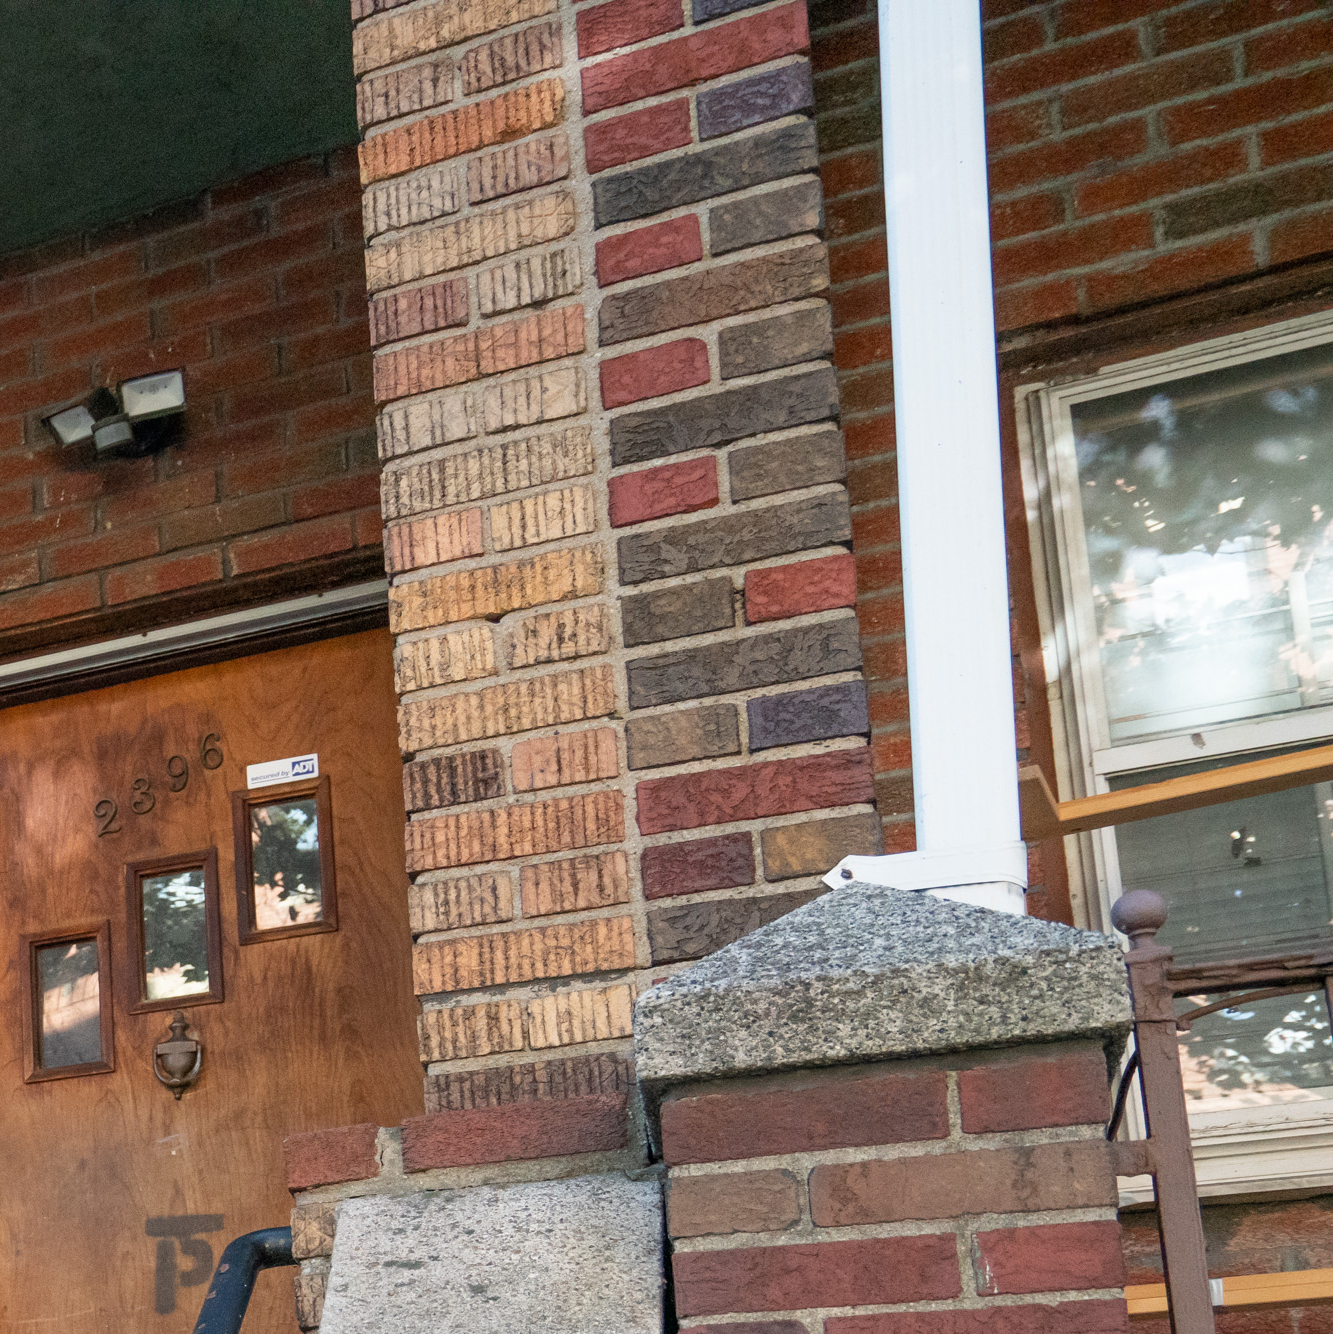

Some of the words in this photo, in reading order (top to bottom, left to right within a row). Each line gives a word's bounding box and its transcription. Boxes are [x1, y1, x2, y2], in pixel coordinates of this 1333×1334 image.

[93, 732, 224, 838] 2396
[251, 772, 280, 781] secured
[292, 761, 315, 775] ADT
